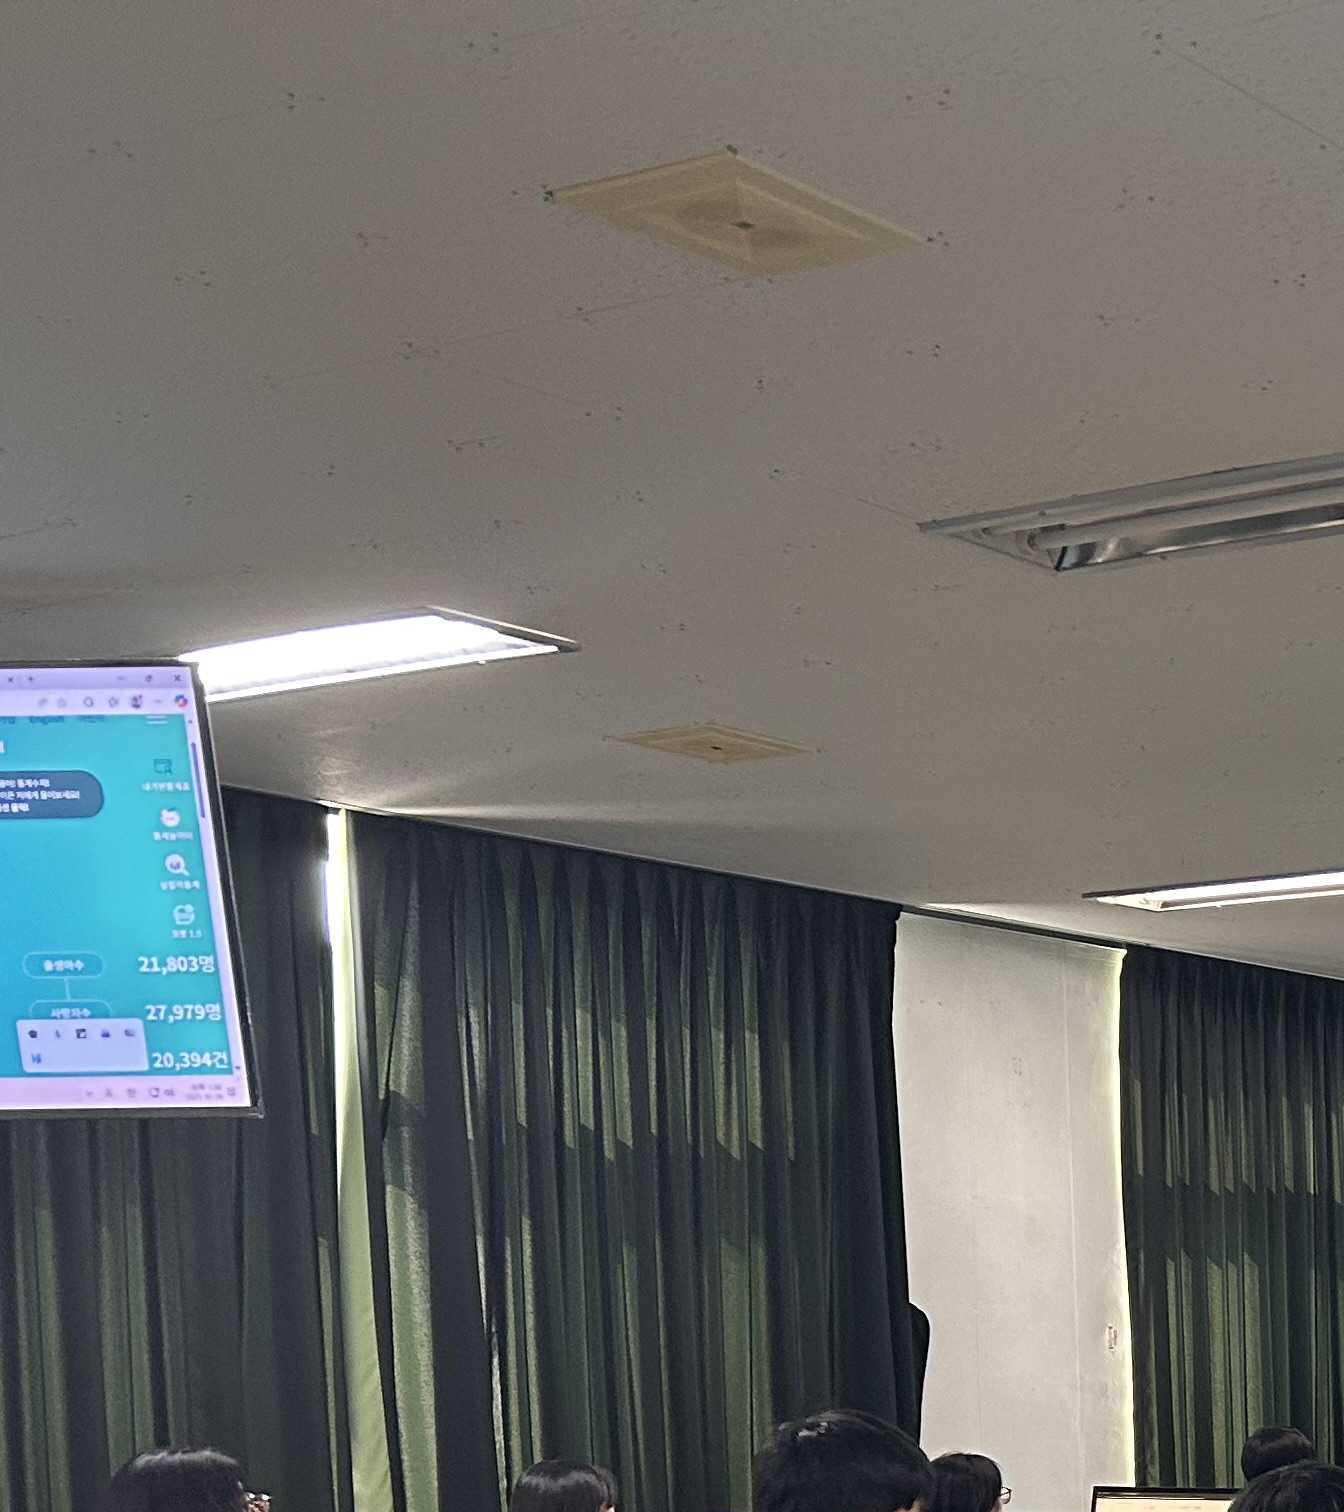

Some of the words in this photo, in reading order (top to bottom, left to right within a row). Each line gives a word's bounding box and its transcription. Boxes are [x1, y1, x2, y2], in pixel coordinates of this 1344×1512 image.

[138, 955, 215, 975] 21,803명
[145, 1003, 222, 1024] 27,979명
[152, 1051, 229, 1071] 20,394건
